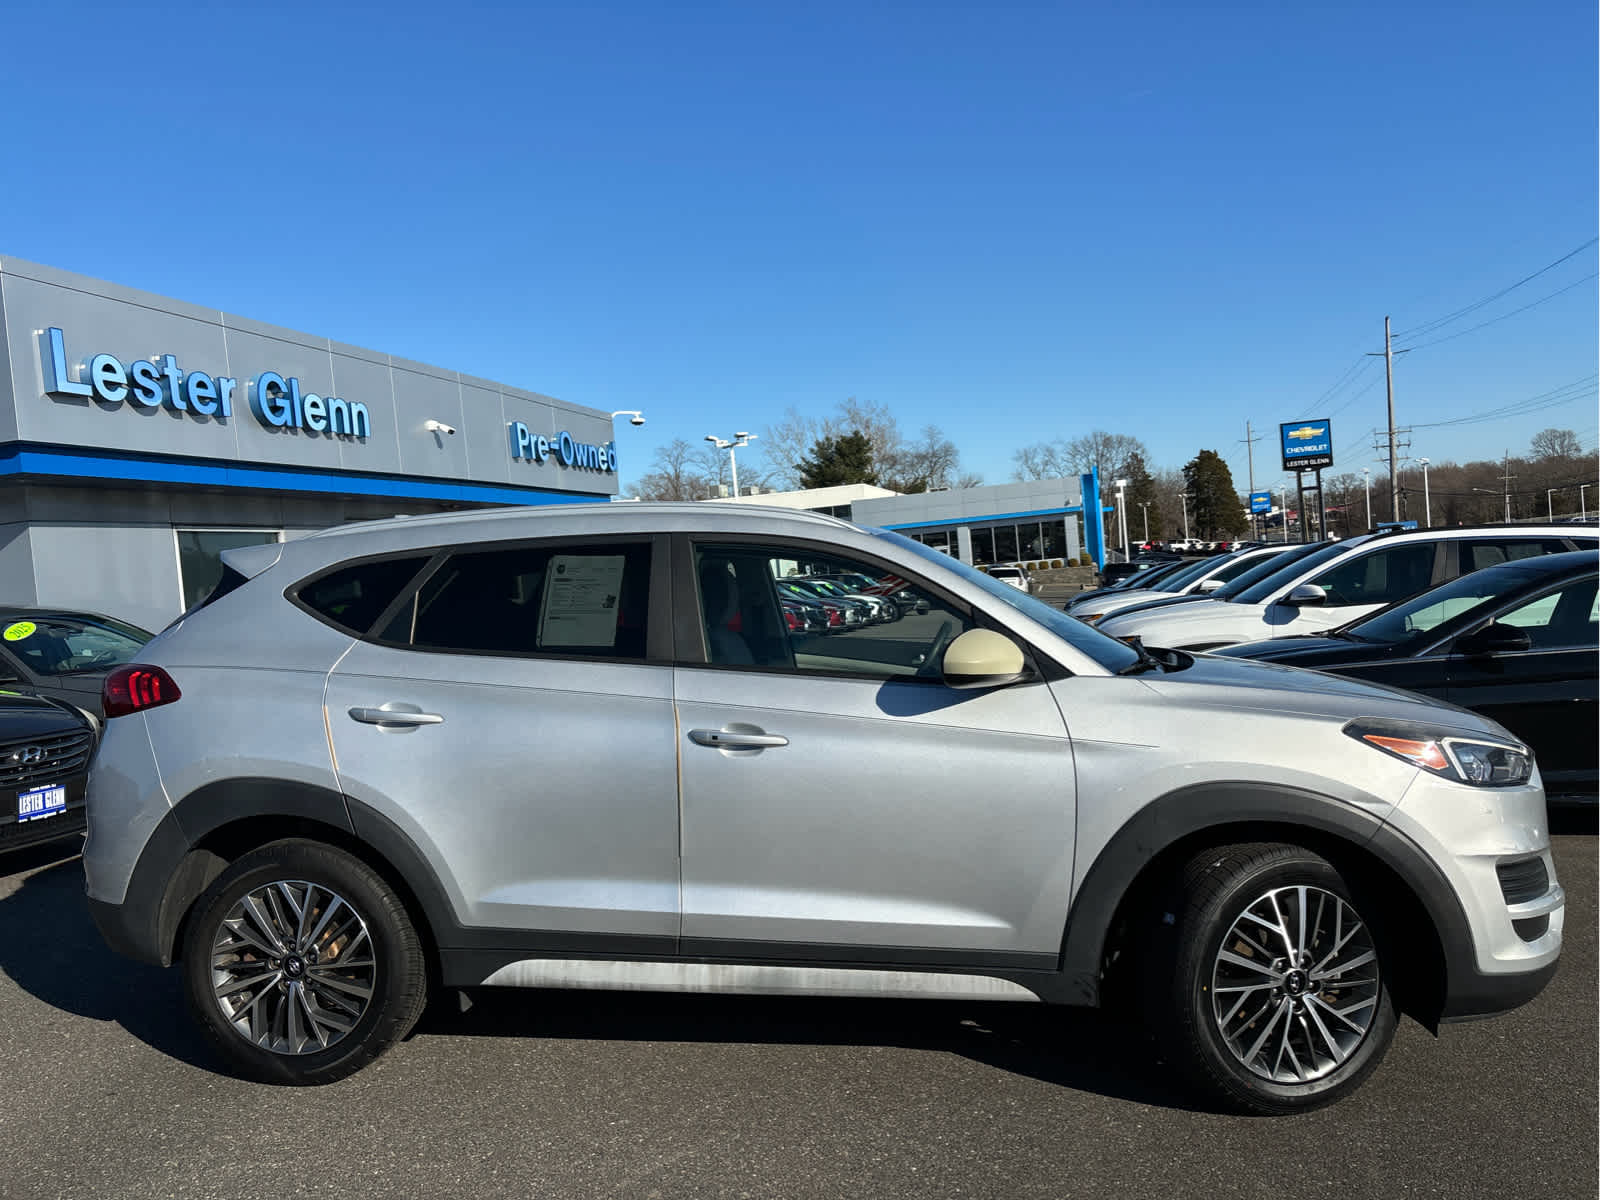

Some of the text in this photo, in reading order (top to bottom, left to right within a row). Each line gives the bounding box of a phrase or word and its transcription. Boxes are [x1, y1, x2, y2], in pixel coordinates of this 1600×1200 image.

[40, 327, 371, 437] Lester Glenn
[509, 421, 617, 471] Pre-Owned
[1286, 444, 1328, 454] CHEVROLET
[1286, 458, 1329, 467] LESTER GLENN
[19, 792, 43, 814] LESTER
